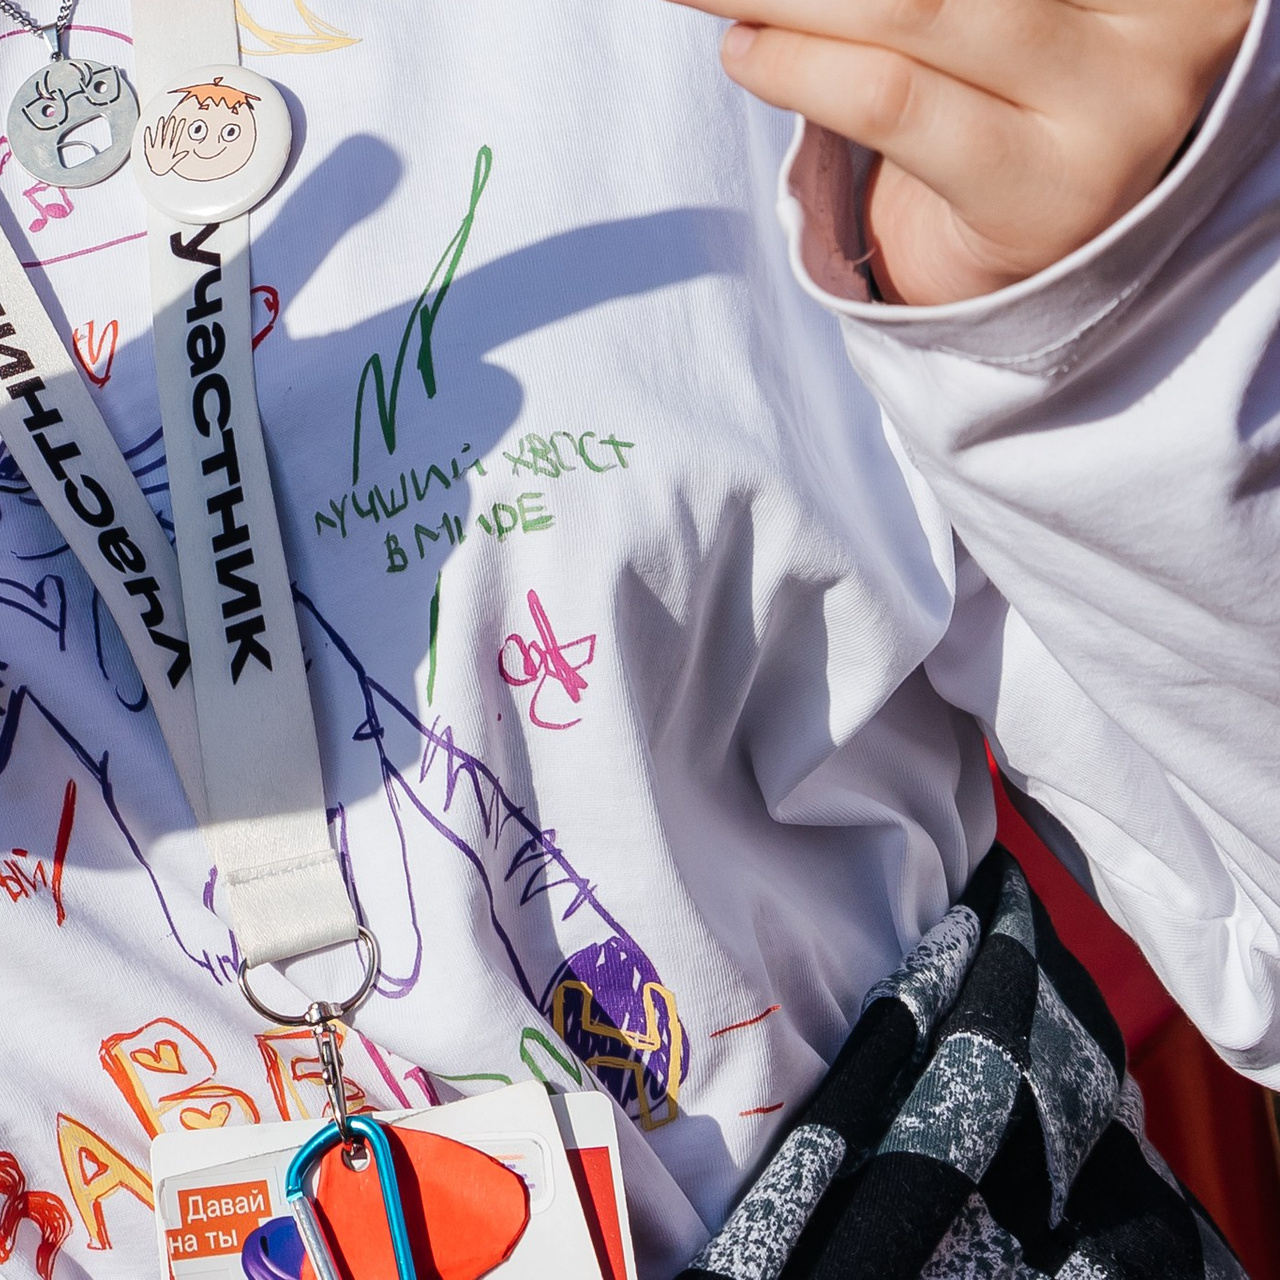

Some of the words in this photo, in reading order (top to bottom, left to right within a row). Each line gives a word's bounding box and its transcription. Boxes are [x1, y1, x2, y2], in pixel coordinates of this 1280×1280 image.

[385, 531, 408, 573] В
[186, 1188, 266, 1224] Давай
[169, 1231, 198, 1255] на
[205, 1227, 238, 1250] ты
